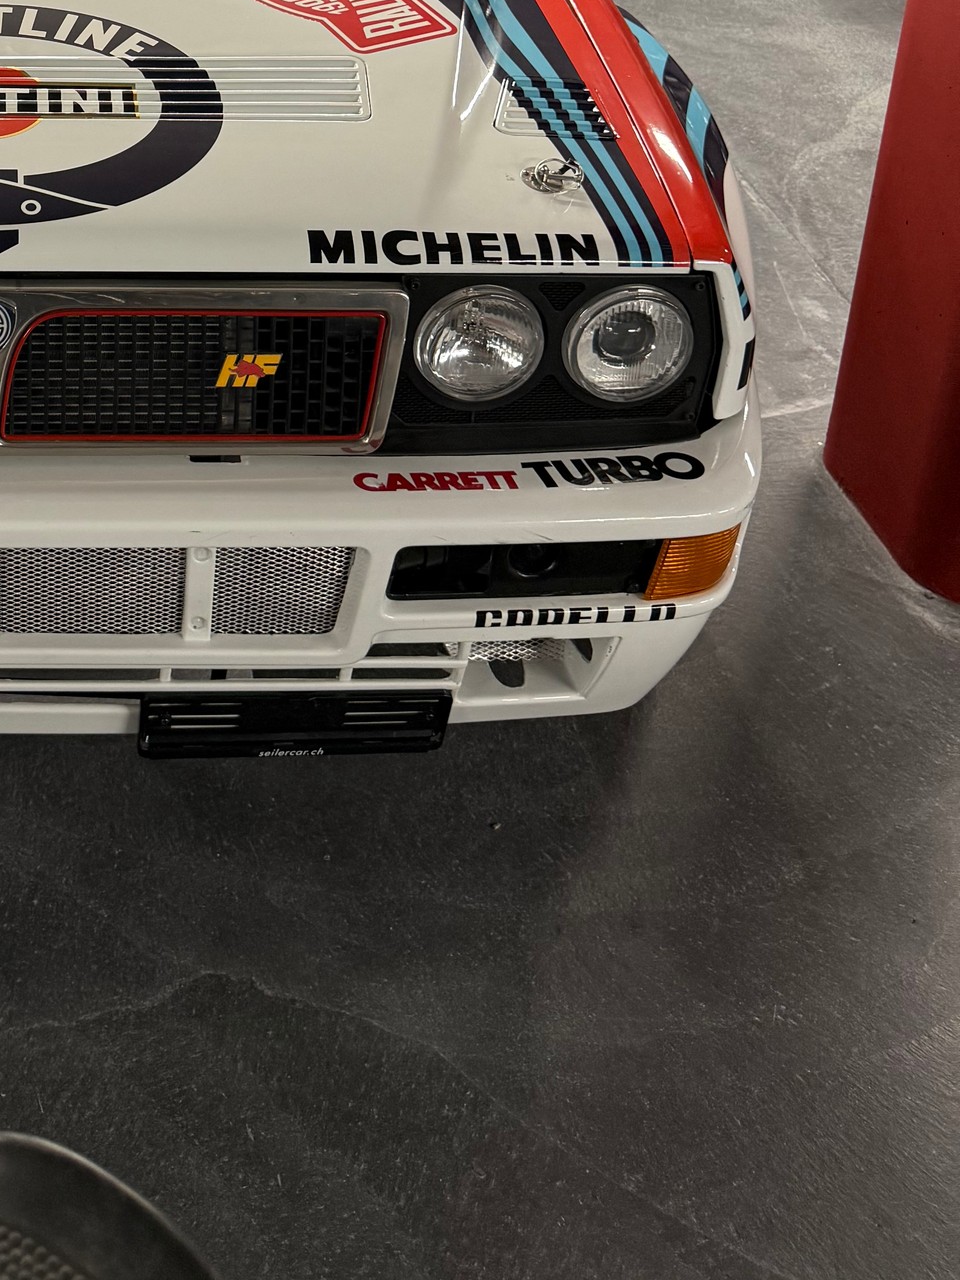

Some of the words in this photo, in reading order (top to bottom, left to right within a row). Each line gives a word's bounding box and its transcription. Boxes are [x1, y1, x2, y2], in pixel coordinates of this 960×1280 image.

[306, 229, 600, 266] MICHELIN
[352, 469, 519, 492] GARRETT
[521, 451, 706, 488] TURBO
[258, 747, 325, 758] seilercar.ch
